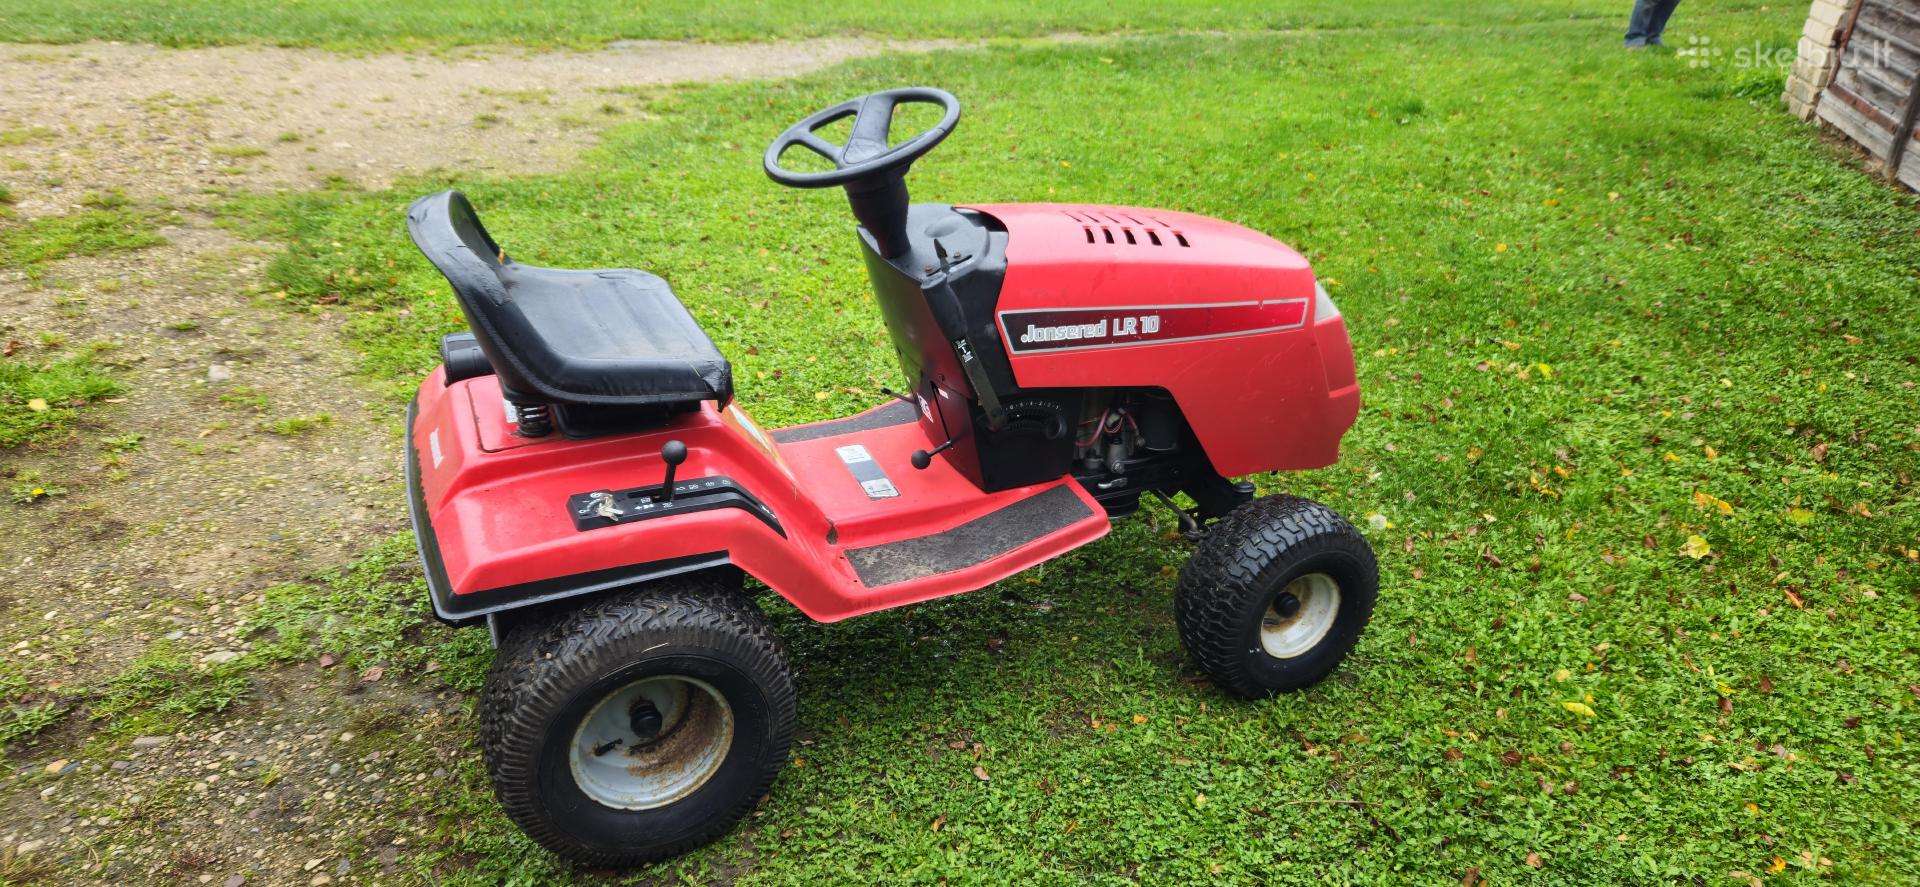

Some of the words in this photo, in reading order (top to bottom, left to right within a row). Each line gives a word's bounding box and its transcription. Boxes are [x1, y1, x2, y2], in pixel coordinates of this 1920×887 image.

[1021, 319, 1107, 342] Jonsered
[1112, 317, 1137, 336] LR
[1139, 315, 1160, 334] 10
